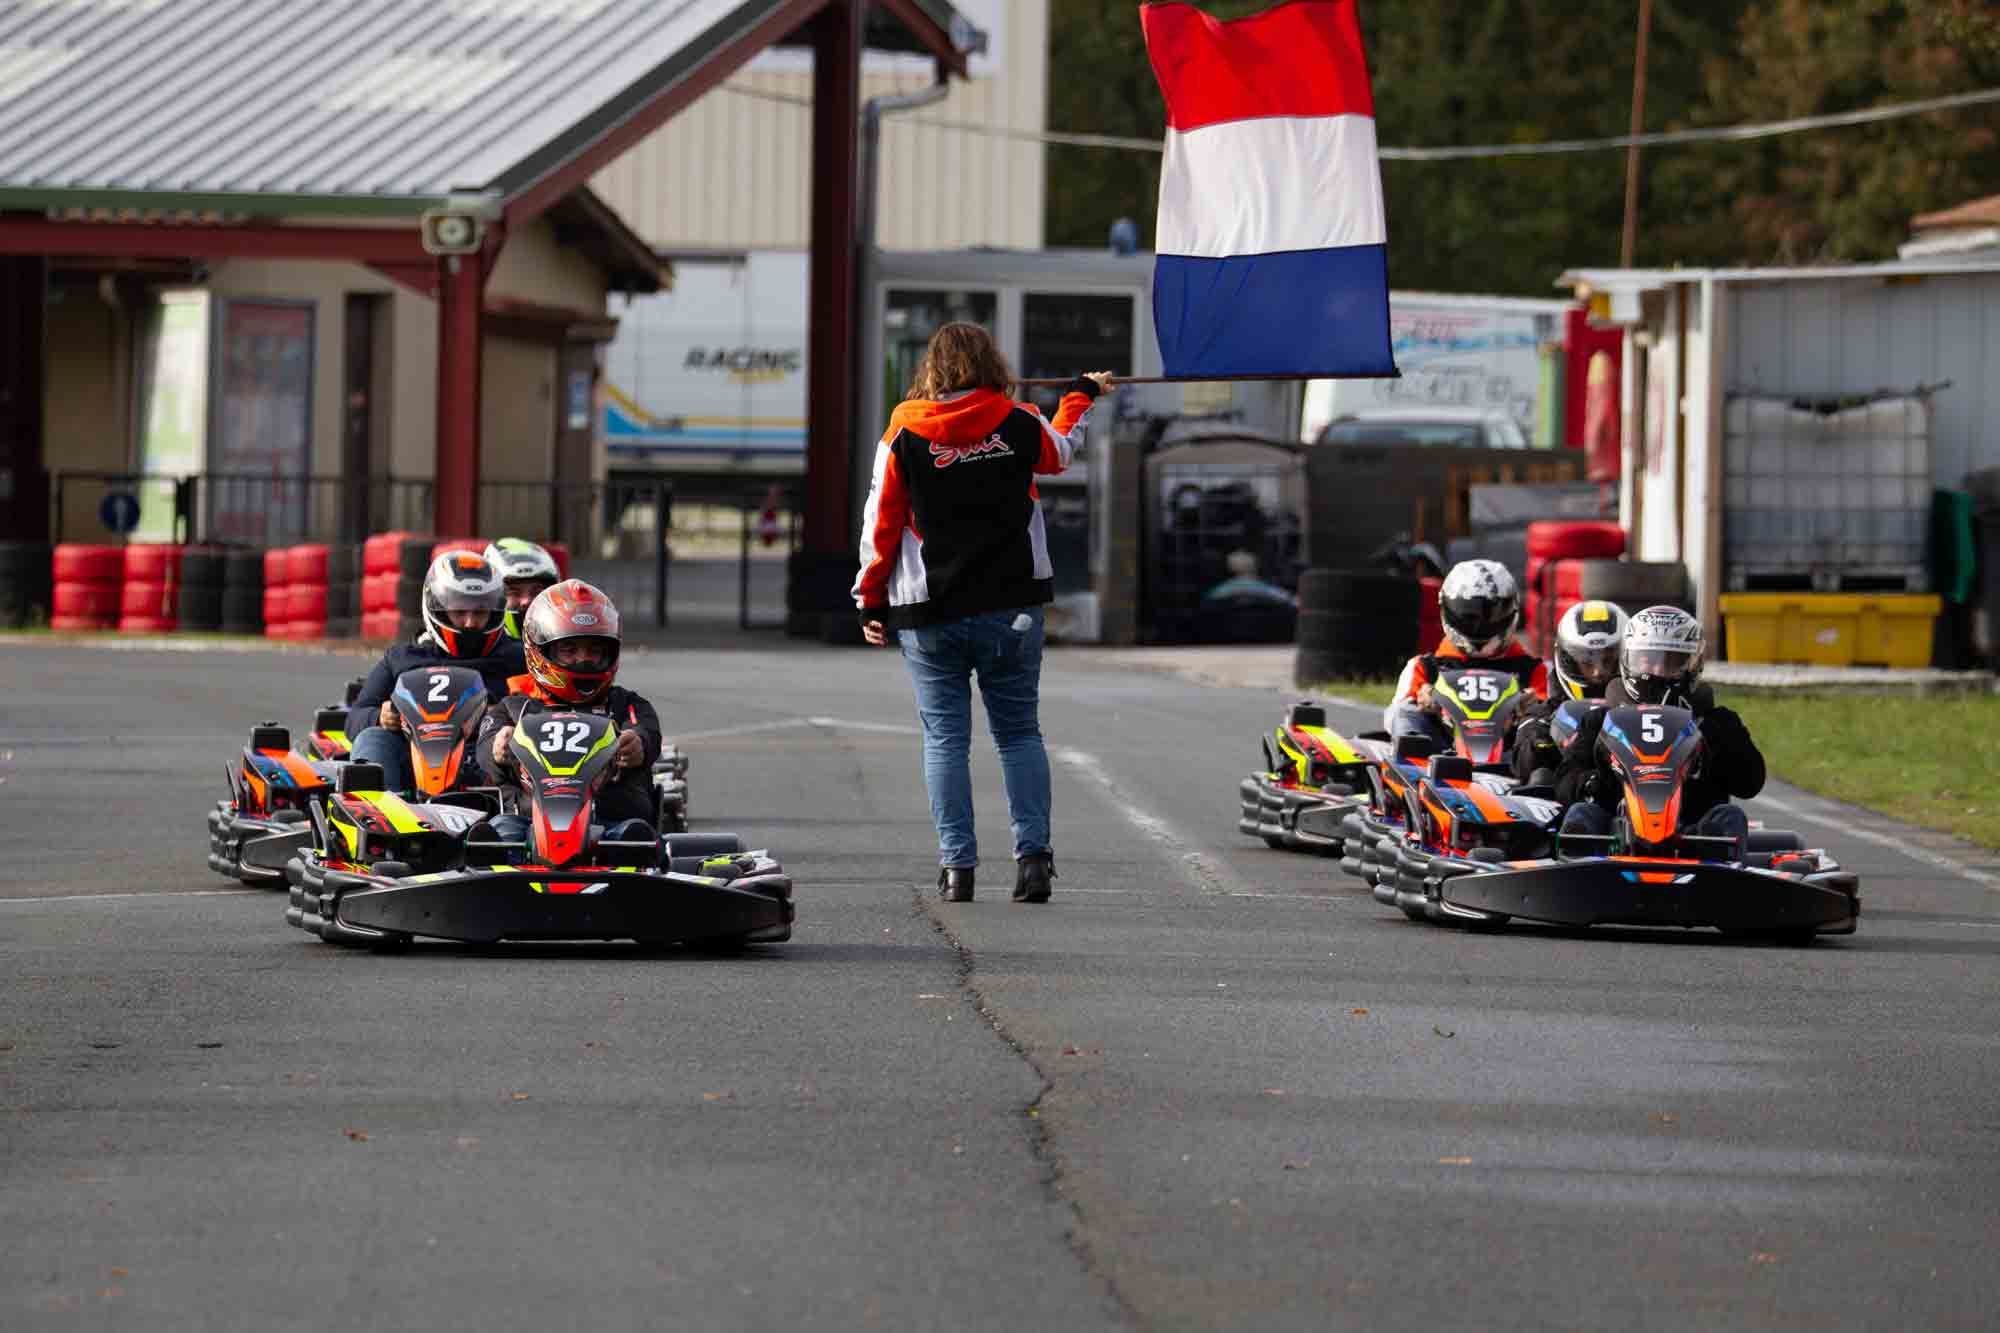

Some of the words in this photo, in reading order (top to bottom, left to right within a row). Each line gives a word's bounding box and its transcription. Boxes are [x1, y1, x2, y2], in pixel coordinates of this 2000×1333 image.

[427, 674, 450, 702] 2
[1457, 676, 1499, 702] 35
[540, 721, 591, 753] 32
[1641, 713, 1664, 743] 5
